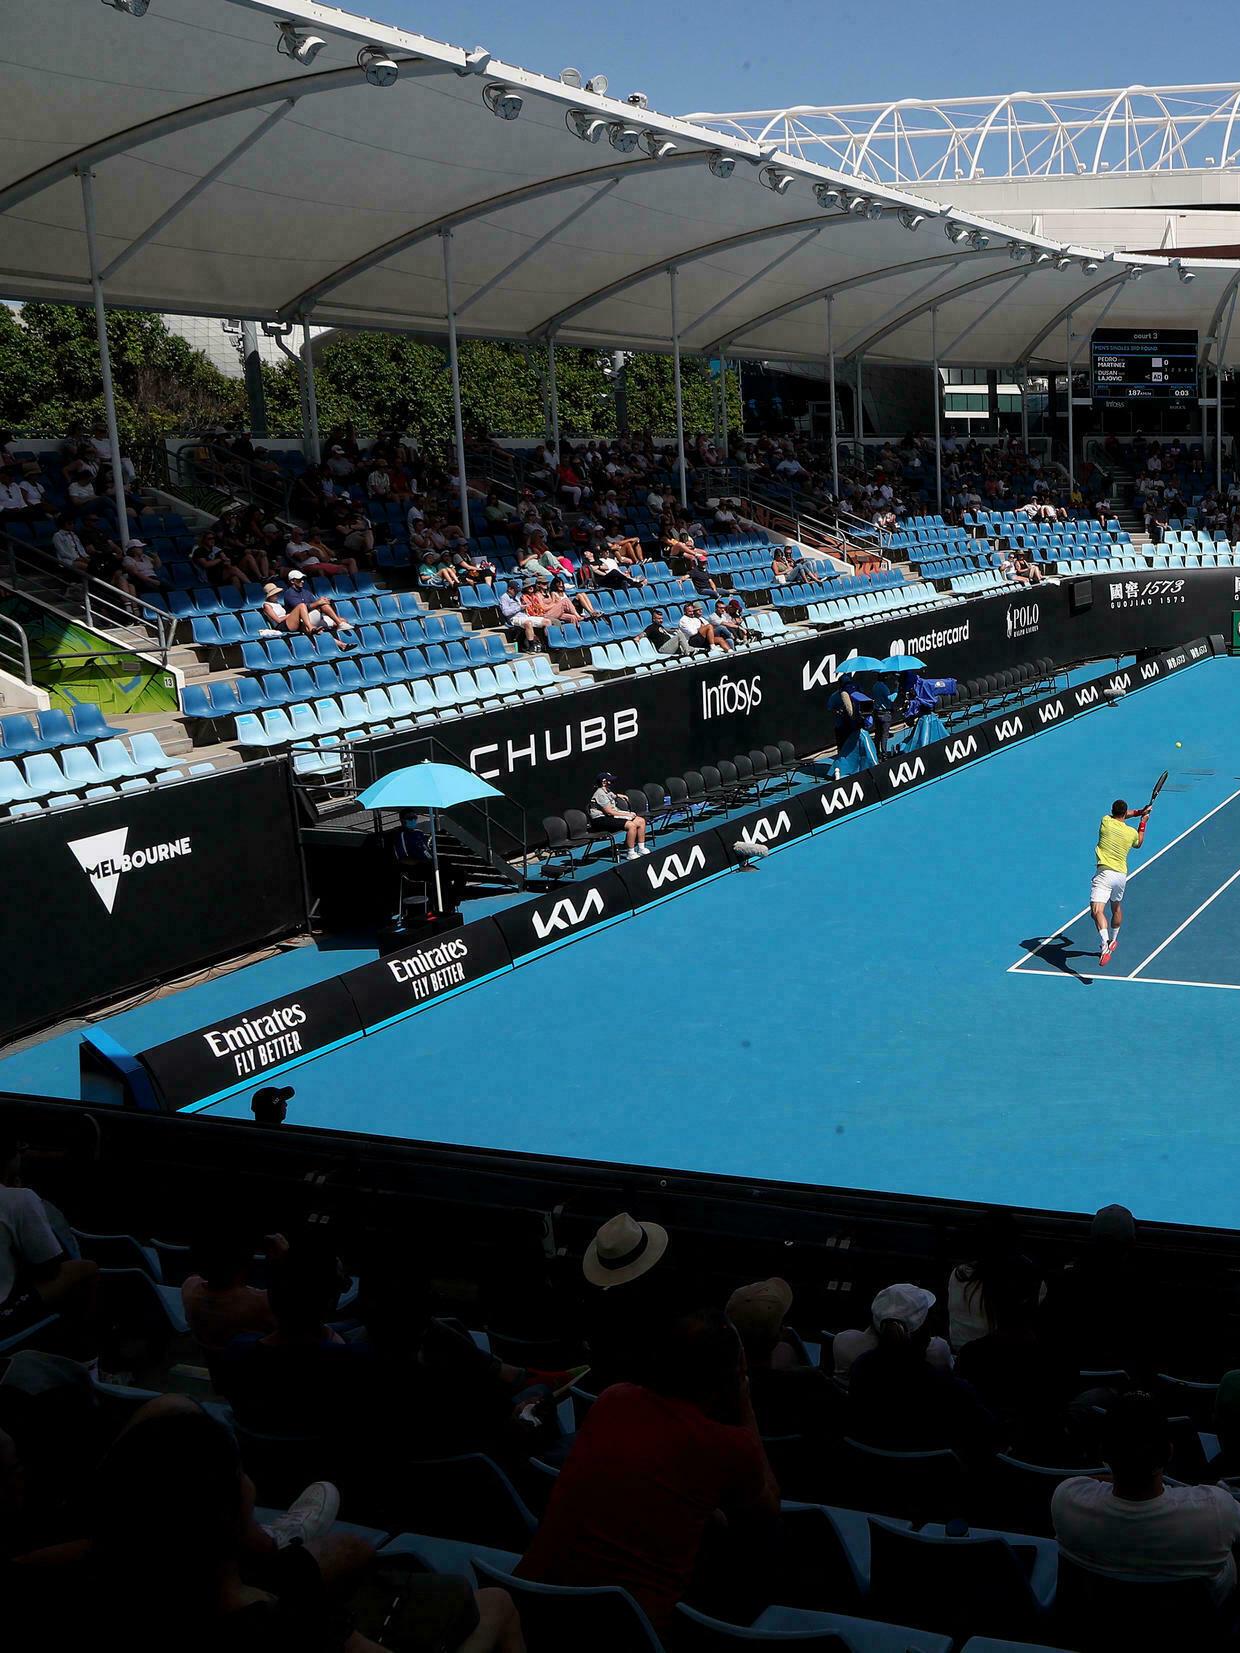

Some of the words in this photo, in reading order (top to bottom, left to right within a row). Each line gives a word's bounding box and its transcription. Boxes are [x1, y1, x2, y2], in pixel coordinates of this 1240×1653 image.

[1014, 603, 1039, 629] POLO
[1110, 598, 1152, 609] GUOJIAO
[1160, 595, 1185, 604] 1573
[908, 620, 970, 655] mastercard
[164, 678, 173, 687] 13
[1110, 673, 1131, 690] KIA
[1140, 662, 1160, 680] KIA
[702, 674, 762, 720] Infosys
[1038, 700, 1064, 723] KIA
[1075, 685, 1098, 706] KIA
[469, 708, 639, 780] CHUBB
[995, 716, 1023, 741] KIA
[945, 735, 978, 763] KIA
[888, 756, 926, 789] KIA
[821, 781, 864, 815] KIA
[742, 810, 791, 844] KIA
[85, 836, 192, 880] MELBOURNE
[646, 844, 706, 889] KIA
[532, 888, 604, 939] KIA
[386, 938, 468, 984] Emirates
[412, 979, 429, 1000] FLY
[431, 964, 466, 993] BETTER
[203, 1004, 307, 1059] Emirates
[234, 1050, 256, 1076] FLY
[259, 1032, 303, 1068] BETTER
